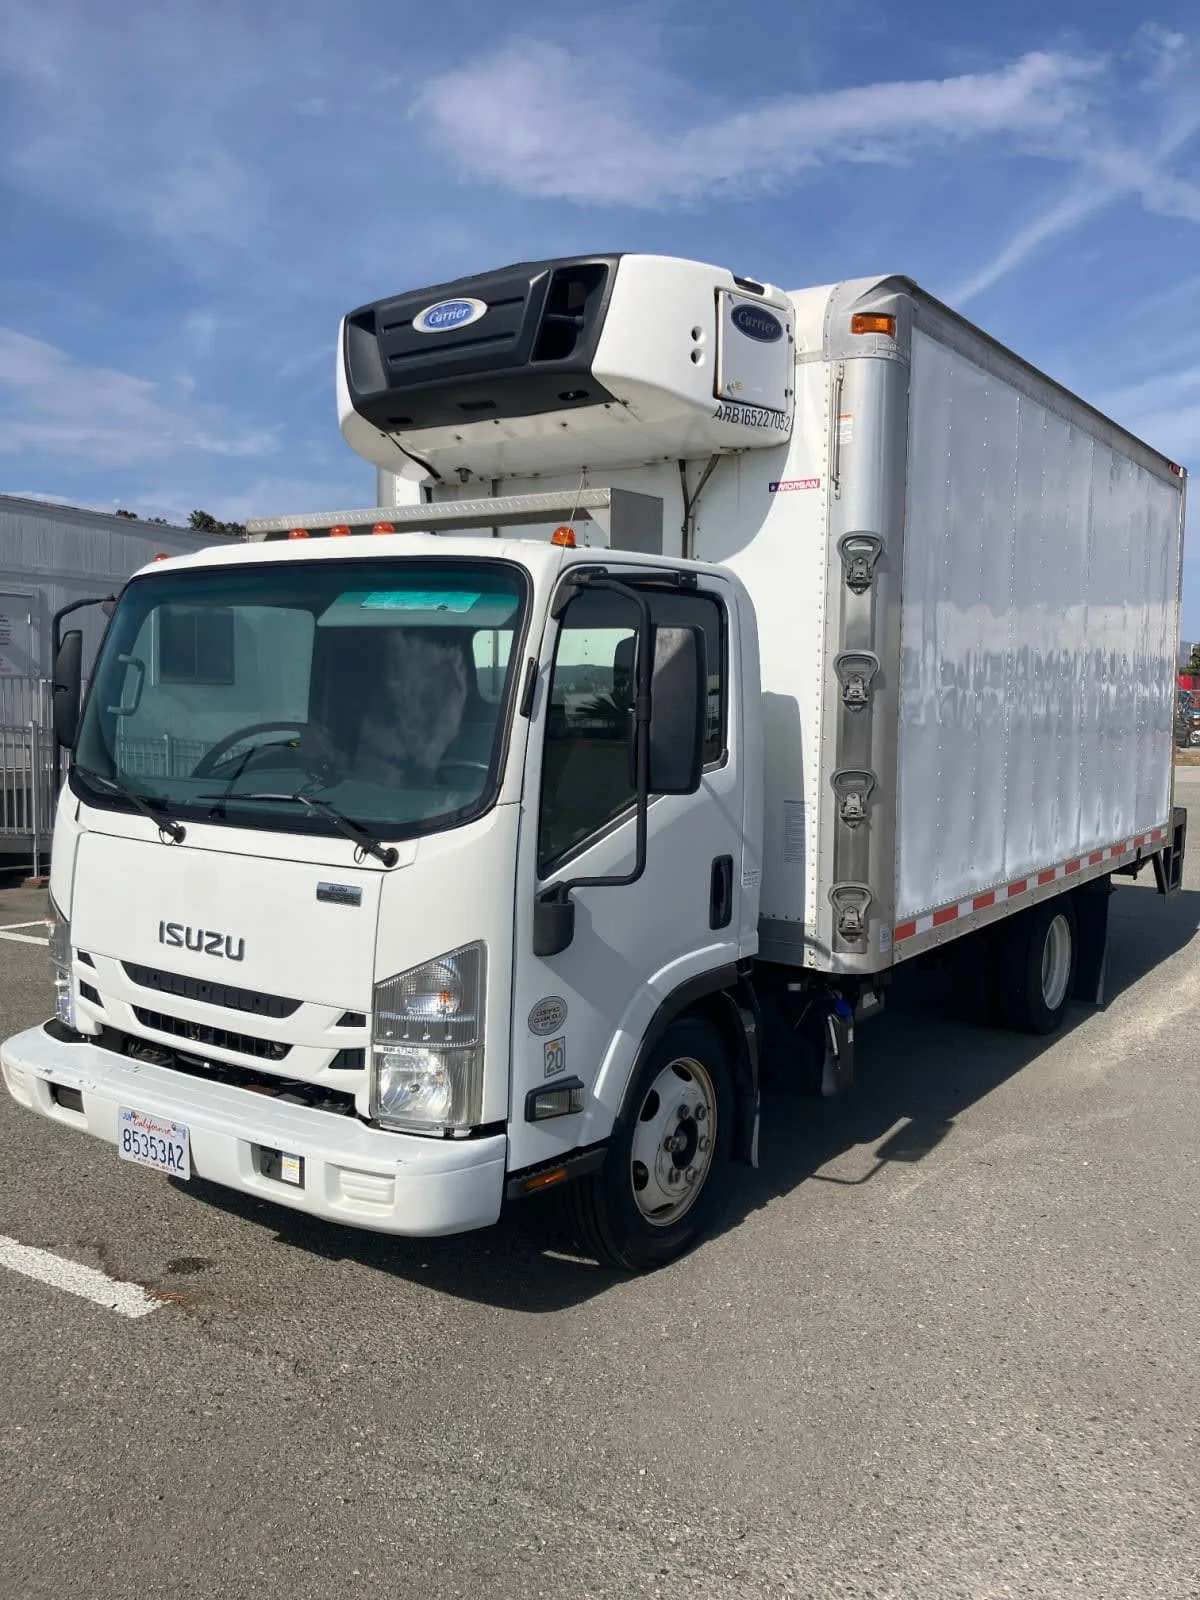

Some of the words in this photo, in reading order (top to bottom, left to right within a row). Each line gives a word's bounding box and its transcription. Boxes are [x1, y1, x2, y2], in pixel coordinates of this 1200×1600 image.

[429, 306, 469, 325] Carrier
[738, 311, 777, 333] Carrier
[712, 405, 791, 433] ARB165227052
[778, 480, 818, 491] MORGAN
[159, 920, 245, 962] ISUZU
[546, 1047, 563, 1073] 20
[132, 1113, 176, 1138] California
[123, 1128, 185, 1171] 85353A2
